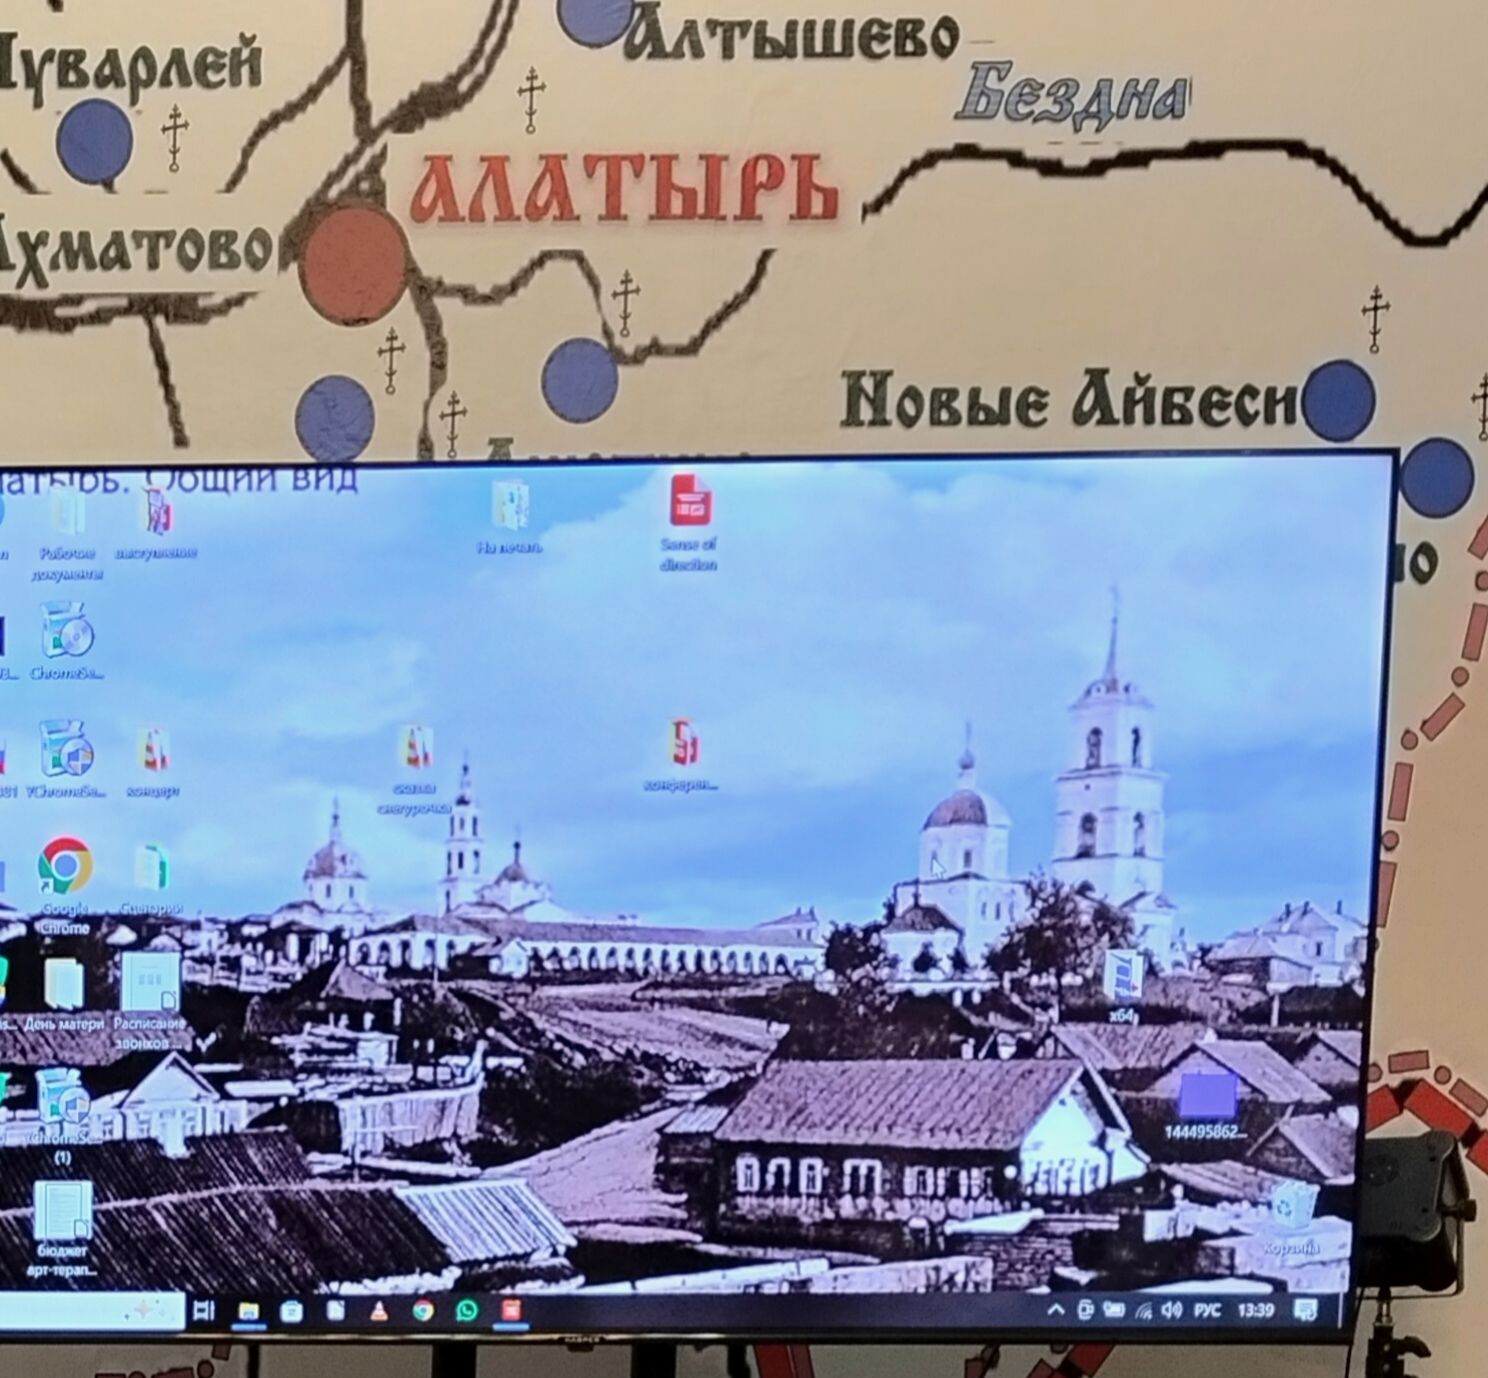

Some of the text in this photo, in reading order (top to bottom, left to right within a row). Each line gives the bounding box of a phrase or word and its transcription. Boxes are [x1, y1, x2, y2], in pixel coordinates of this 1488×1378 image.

[624, 2, 959, 59] Алтышево
[954, 60, 1188, 132] Бездна
[409, 153, 839, 223] АЛАТЫРЬ
[840, 367, 1298, 428] Новые Айбеси
[1194, 1302, 1222, 1318] РУС
[1238, 1302, 1275, 1318] 13:39
